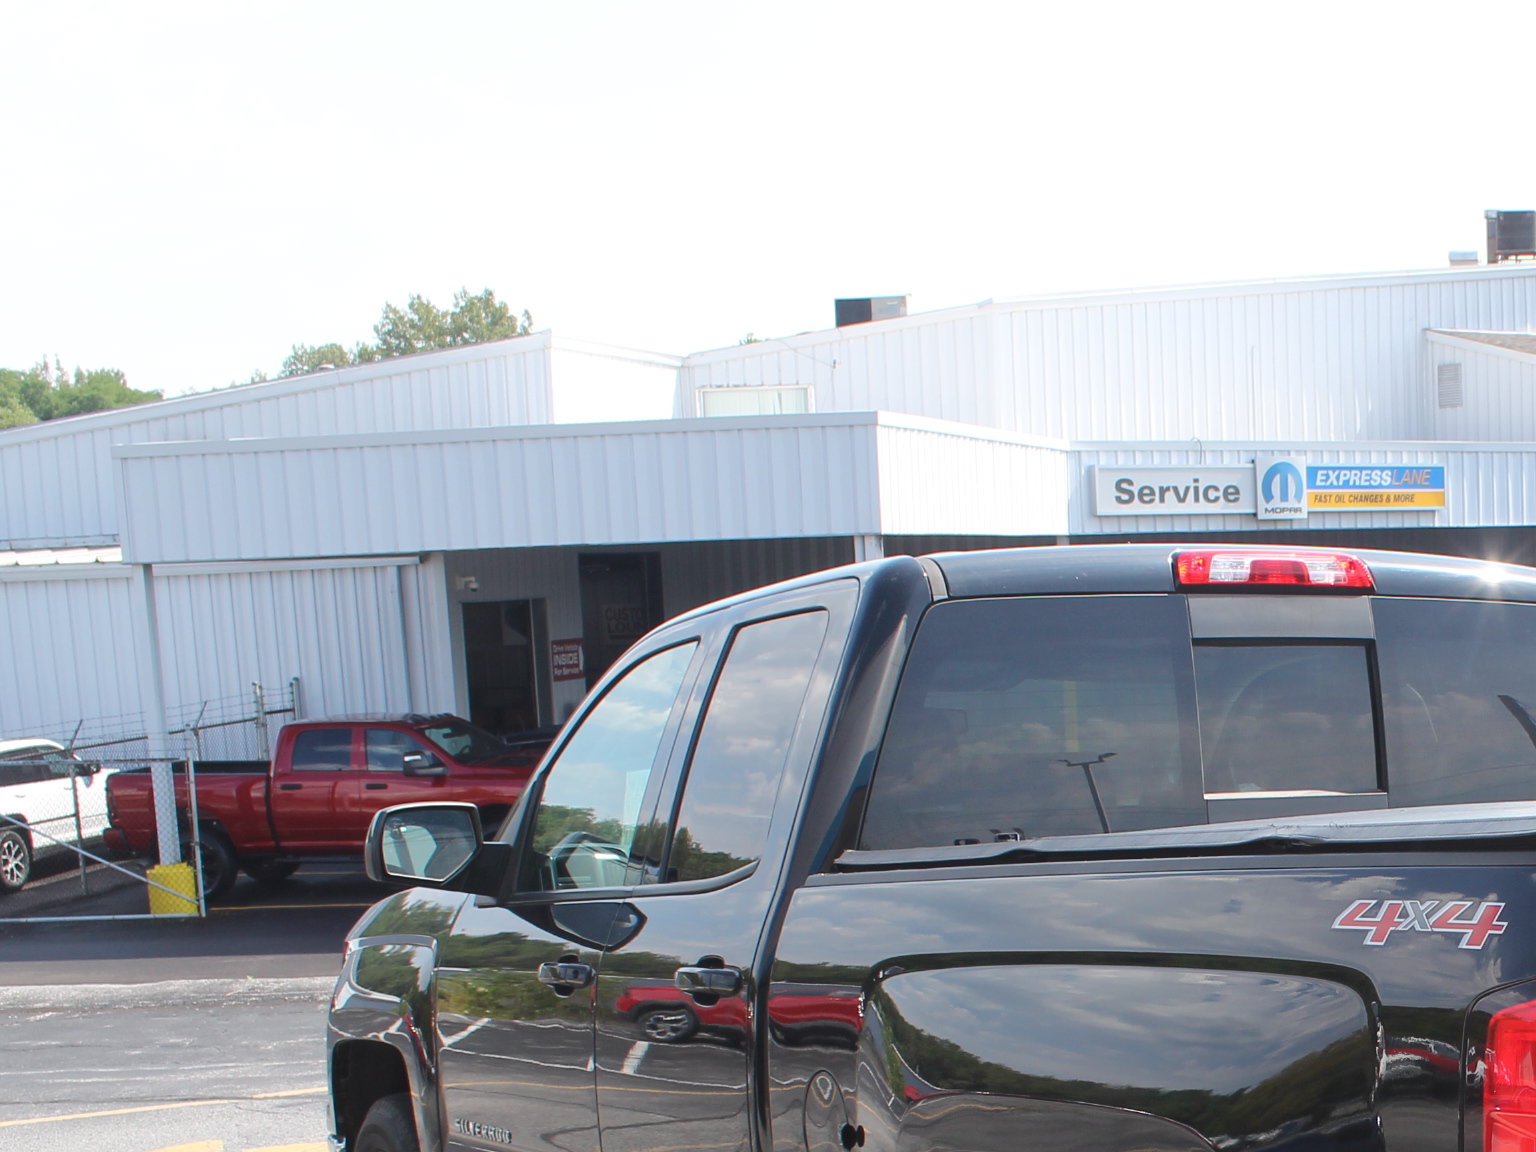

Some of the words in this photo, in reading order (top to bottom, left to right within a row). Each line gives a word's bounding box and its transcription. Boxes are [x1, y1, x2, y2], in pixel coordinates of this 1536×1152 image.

[1114, 478, 1241, 505] Service
[1314, 494, 1332, 504] FAST
[1335, 494, 1346, 504] OIL
[1348, 494, 1383, 504] CHANGES
[1384, 494, 1391, 503] &
[1393, 493, 1415, 503] MORE
[553, 653, 579, 667] INSIDE
